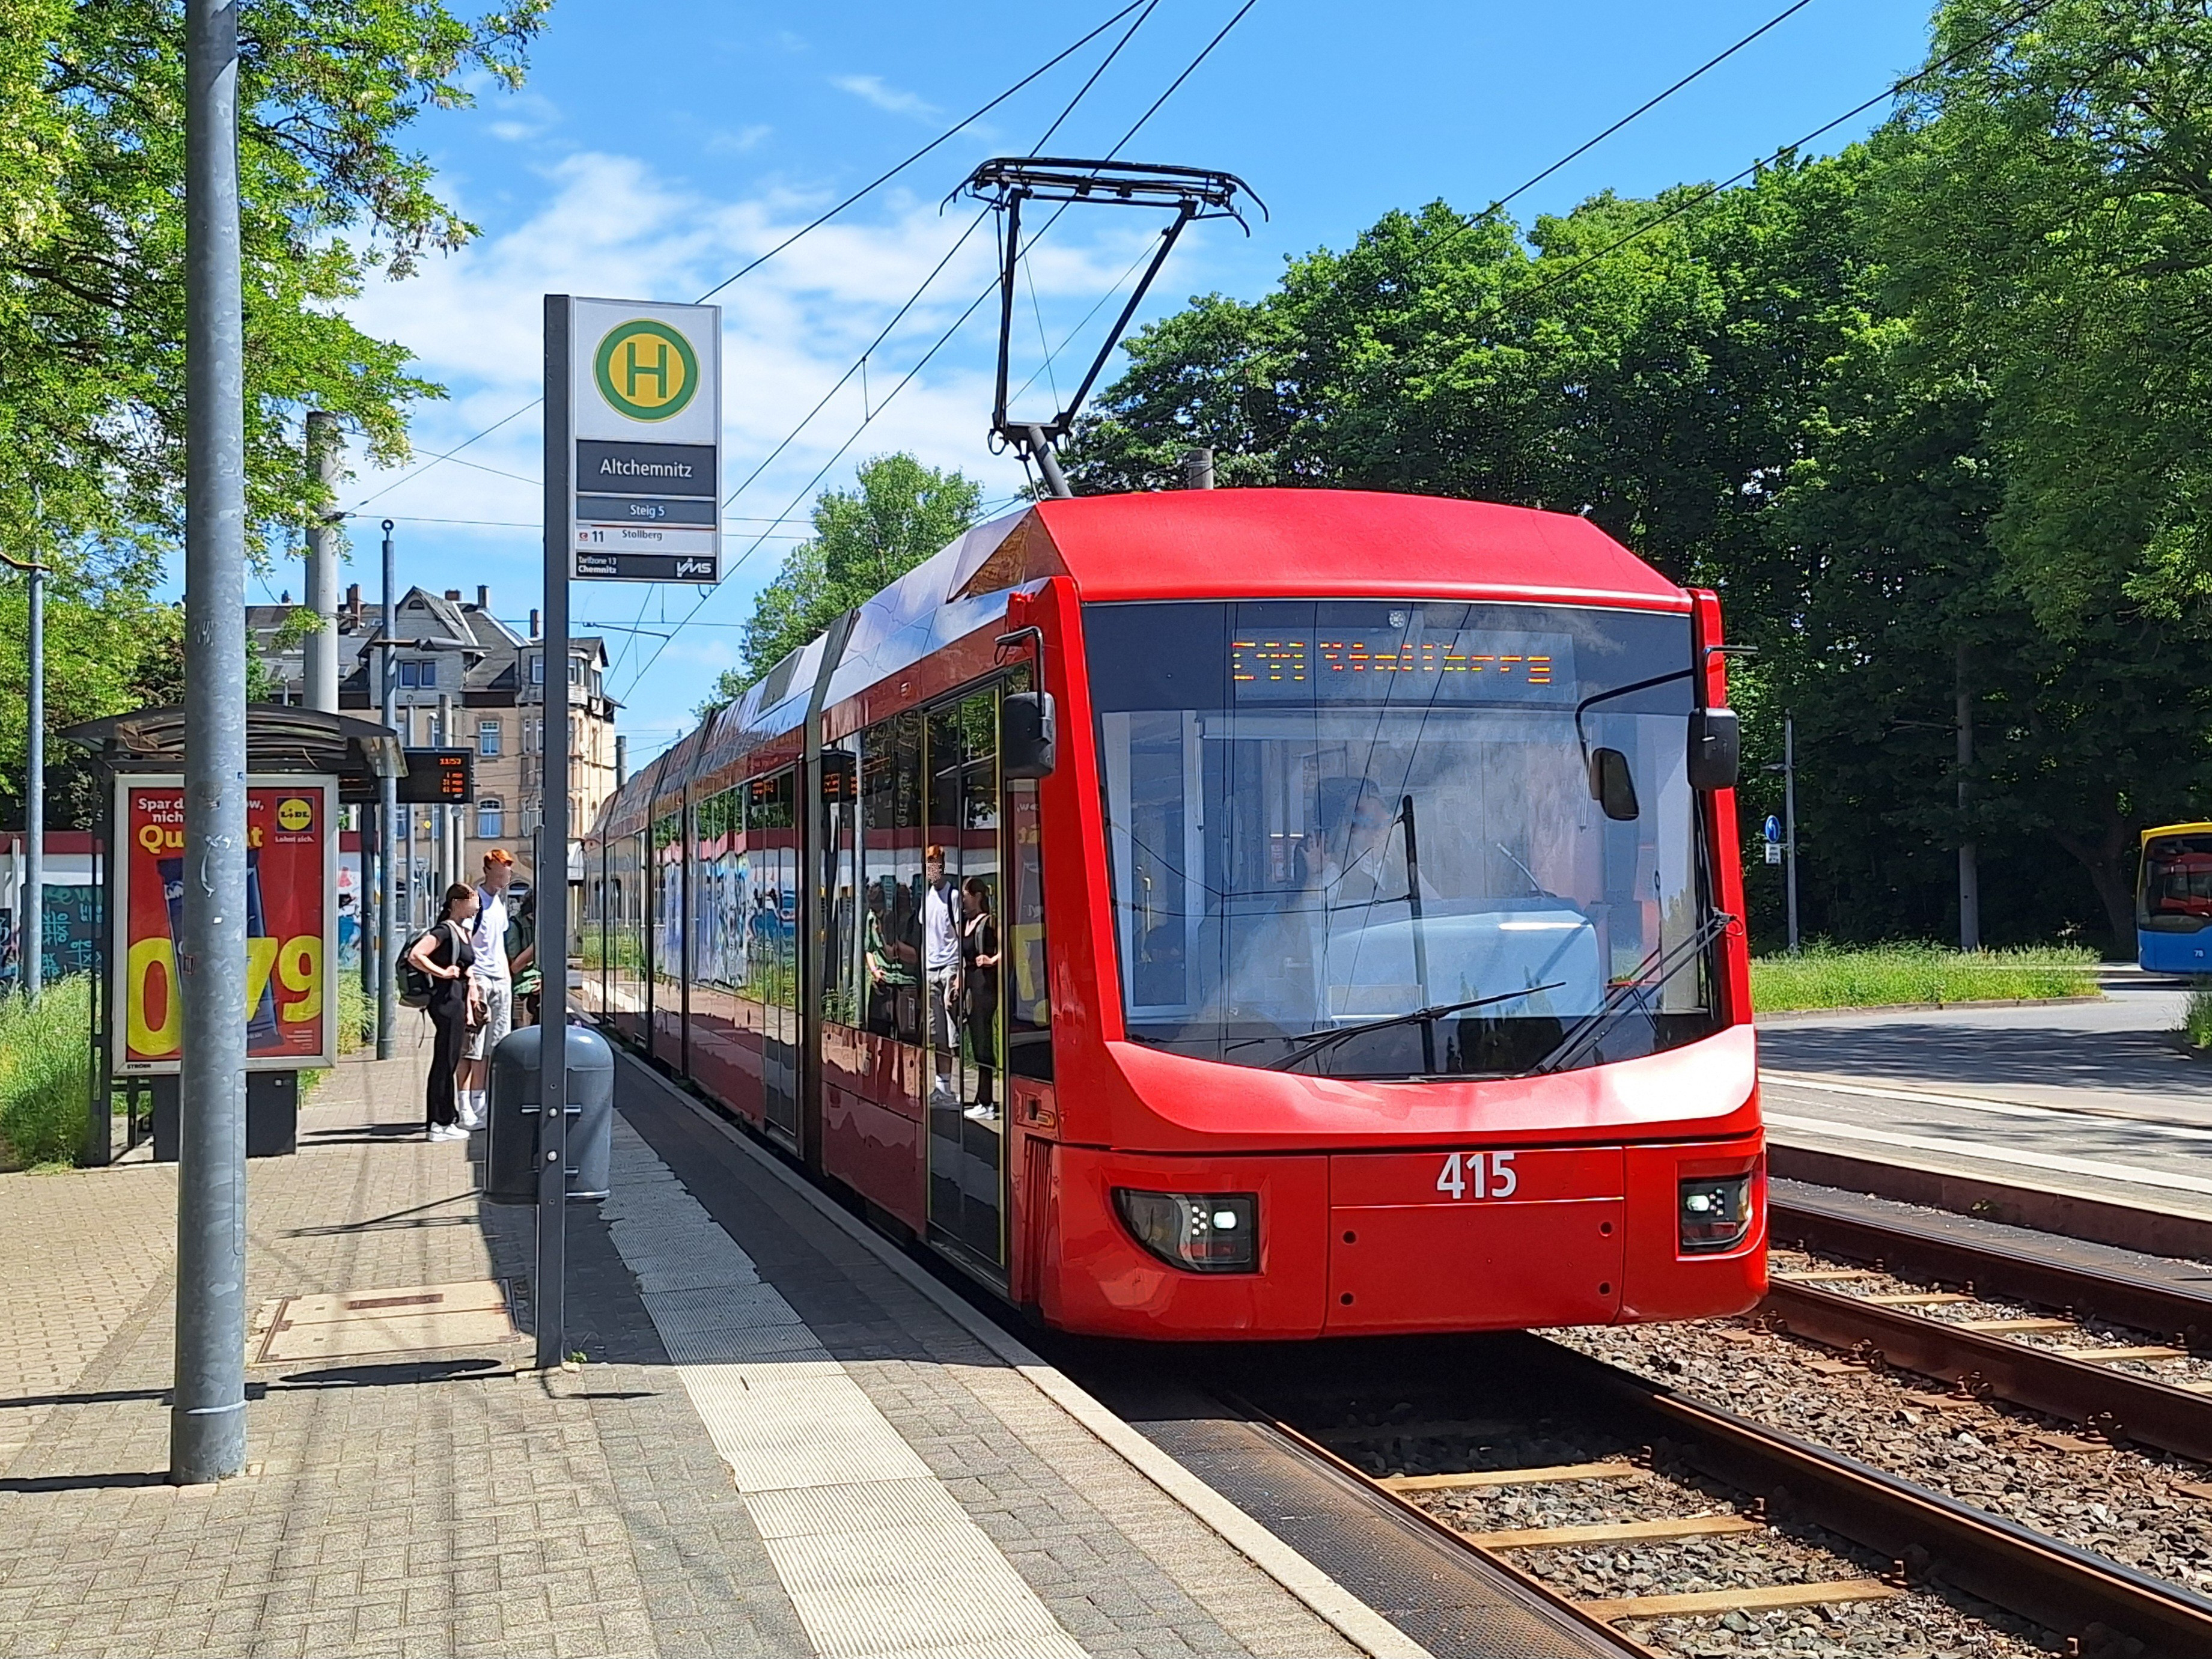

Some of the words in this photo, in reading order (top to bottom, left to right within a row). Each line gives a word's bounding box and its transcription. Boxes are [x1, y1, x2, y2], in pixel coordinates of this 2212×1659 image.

[627, 342, 667, 398] H
[600, 458, 692, 478] Altchemnitz
[630, 504, 656, 519] Steig
[658, 505, 665, 516] 5
[592, 531, 604, 543] 11
[622, 530, 663, 541] Stollberg
[578, 565, 617, 574] Chemnitz
[138, 797, 172, 812] Spar
[1437, 1152, 1517, 1199] 415
